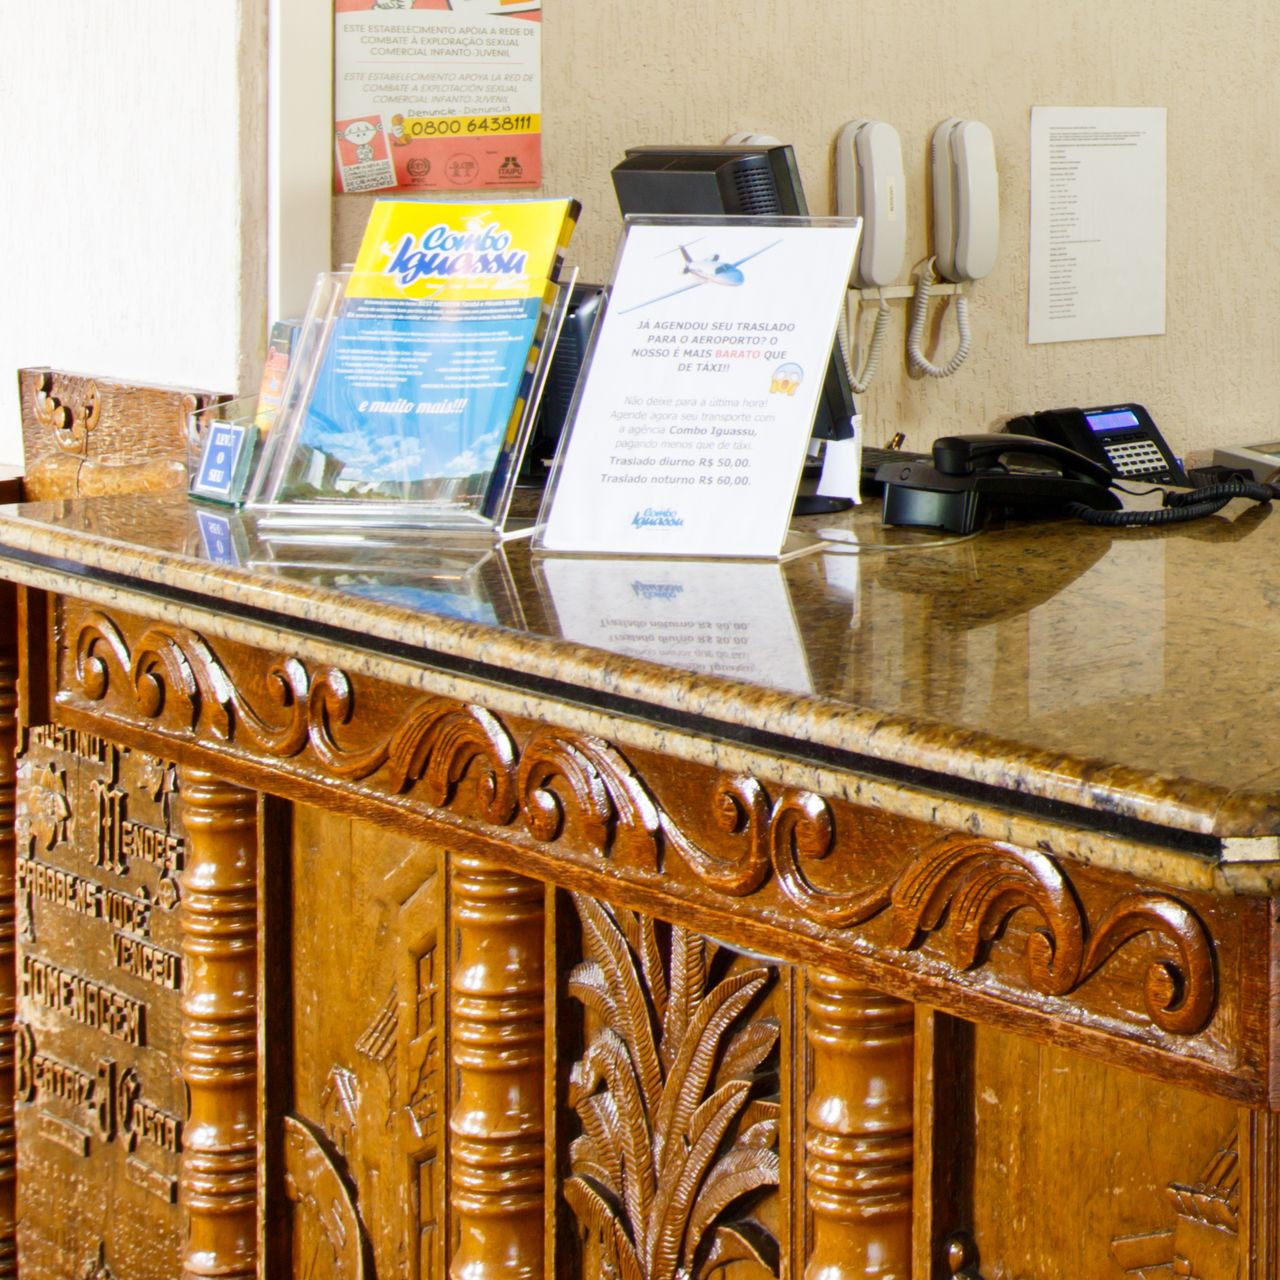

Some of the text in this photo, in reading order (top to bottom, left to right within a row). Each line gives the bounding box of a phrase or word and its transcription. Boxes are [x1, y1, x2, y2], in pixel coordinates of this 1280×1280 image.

[369, 25, 455, 34] ESTABELECIMENTO
[459, 25, 487, 35] APÓIA
[499, 28, 521, 36] REDE
[523, 28, 534, 36] DE
[361, 36, 408, 44] COMBATE
[421, 36, 483, 47] EXPLORAÇÃO
[486, 38, 519, 46] SEXUAL
[370, 48, 427, 56] COMERCIAL
[412, 116, 531, 135] 0800 6438111
[423, 223, 510, 251] Combo
[388, 236, 527, 284] Iguassu
[637, 321, 795, 331] JÁ AGENDOU SEU TRASLADO
[647, 335, 676, 343] PARA
[691, 336, 766, 345] AEROPORTO?
[770, 337, 778, 345] O
[632, 349, 670, 357] NOSSO
[674, 348, 680, 357] É
[683, 350, 712, 358] MAIS
[764, 351, 787, 360] QUE
[677, 362, 730, 372] DE TÁXI!!
[358, 398, 467, 414] e muito mais!!!
[669, 426, 757, 437] Combo Iguassu,
[610, 457, 751, 467] Traslado diurno R$ 50,00.
[601, 474, 751, 485] Traslado noturno R$ 60,00.
[112, 932, 181, 990] VENCEU
[23, 955, 147, 1048] HOMENAGEM
